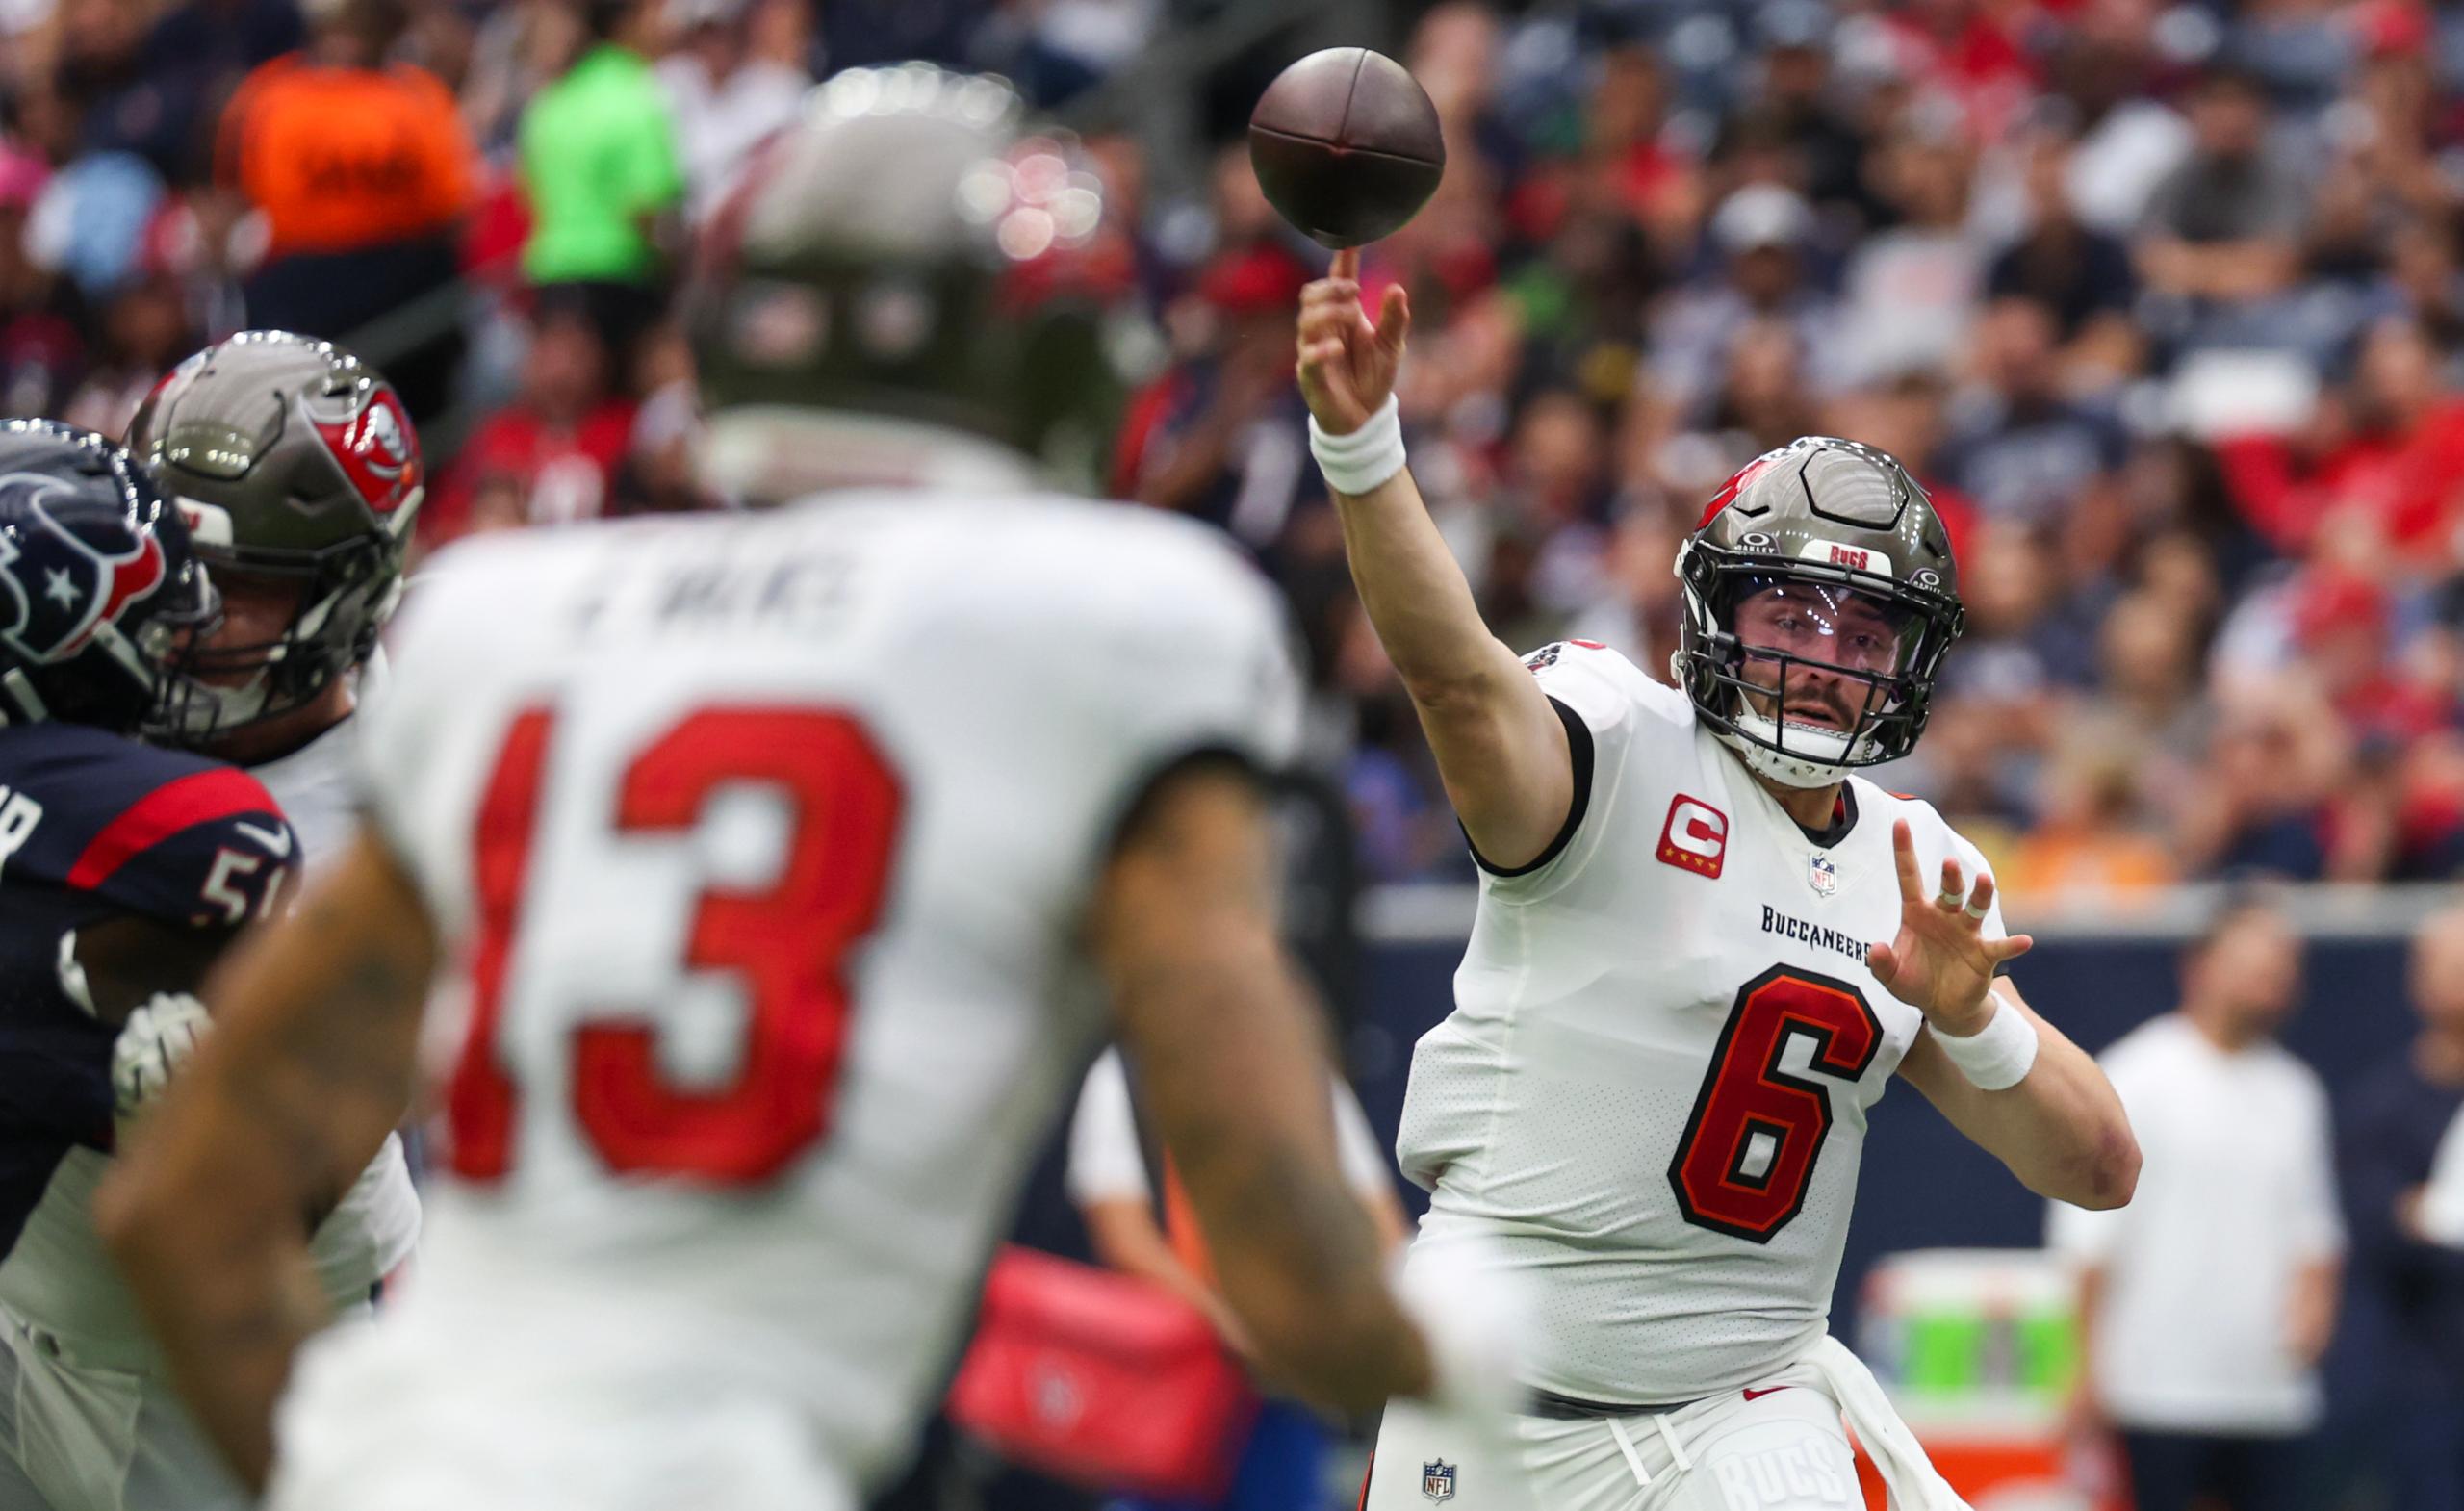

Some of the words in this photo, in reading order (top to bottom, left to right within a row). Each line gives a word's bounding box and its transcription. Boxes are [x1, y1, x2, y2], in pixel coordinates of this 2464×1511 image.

[1830, 544, 1869, 570] BUCS
[1669, 802, 1725, 858] C
[1814, 870, 1834, 888] NFL
[445, 699, 909, 1188] 13
[1666, 962, 1884, 1245] 6
[1426, 1476, 1450, 1496] NFL
